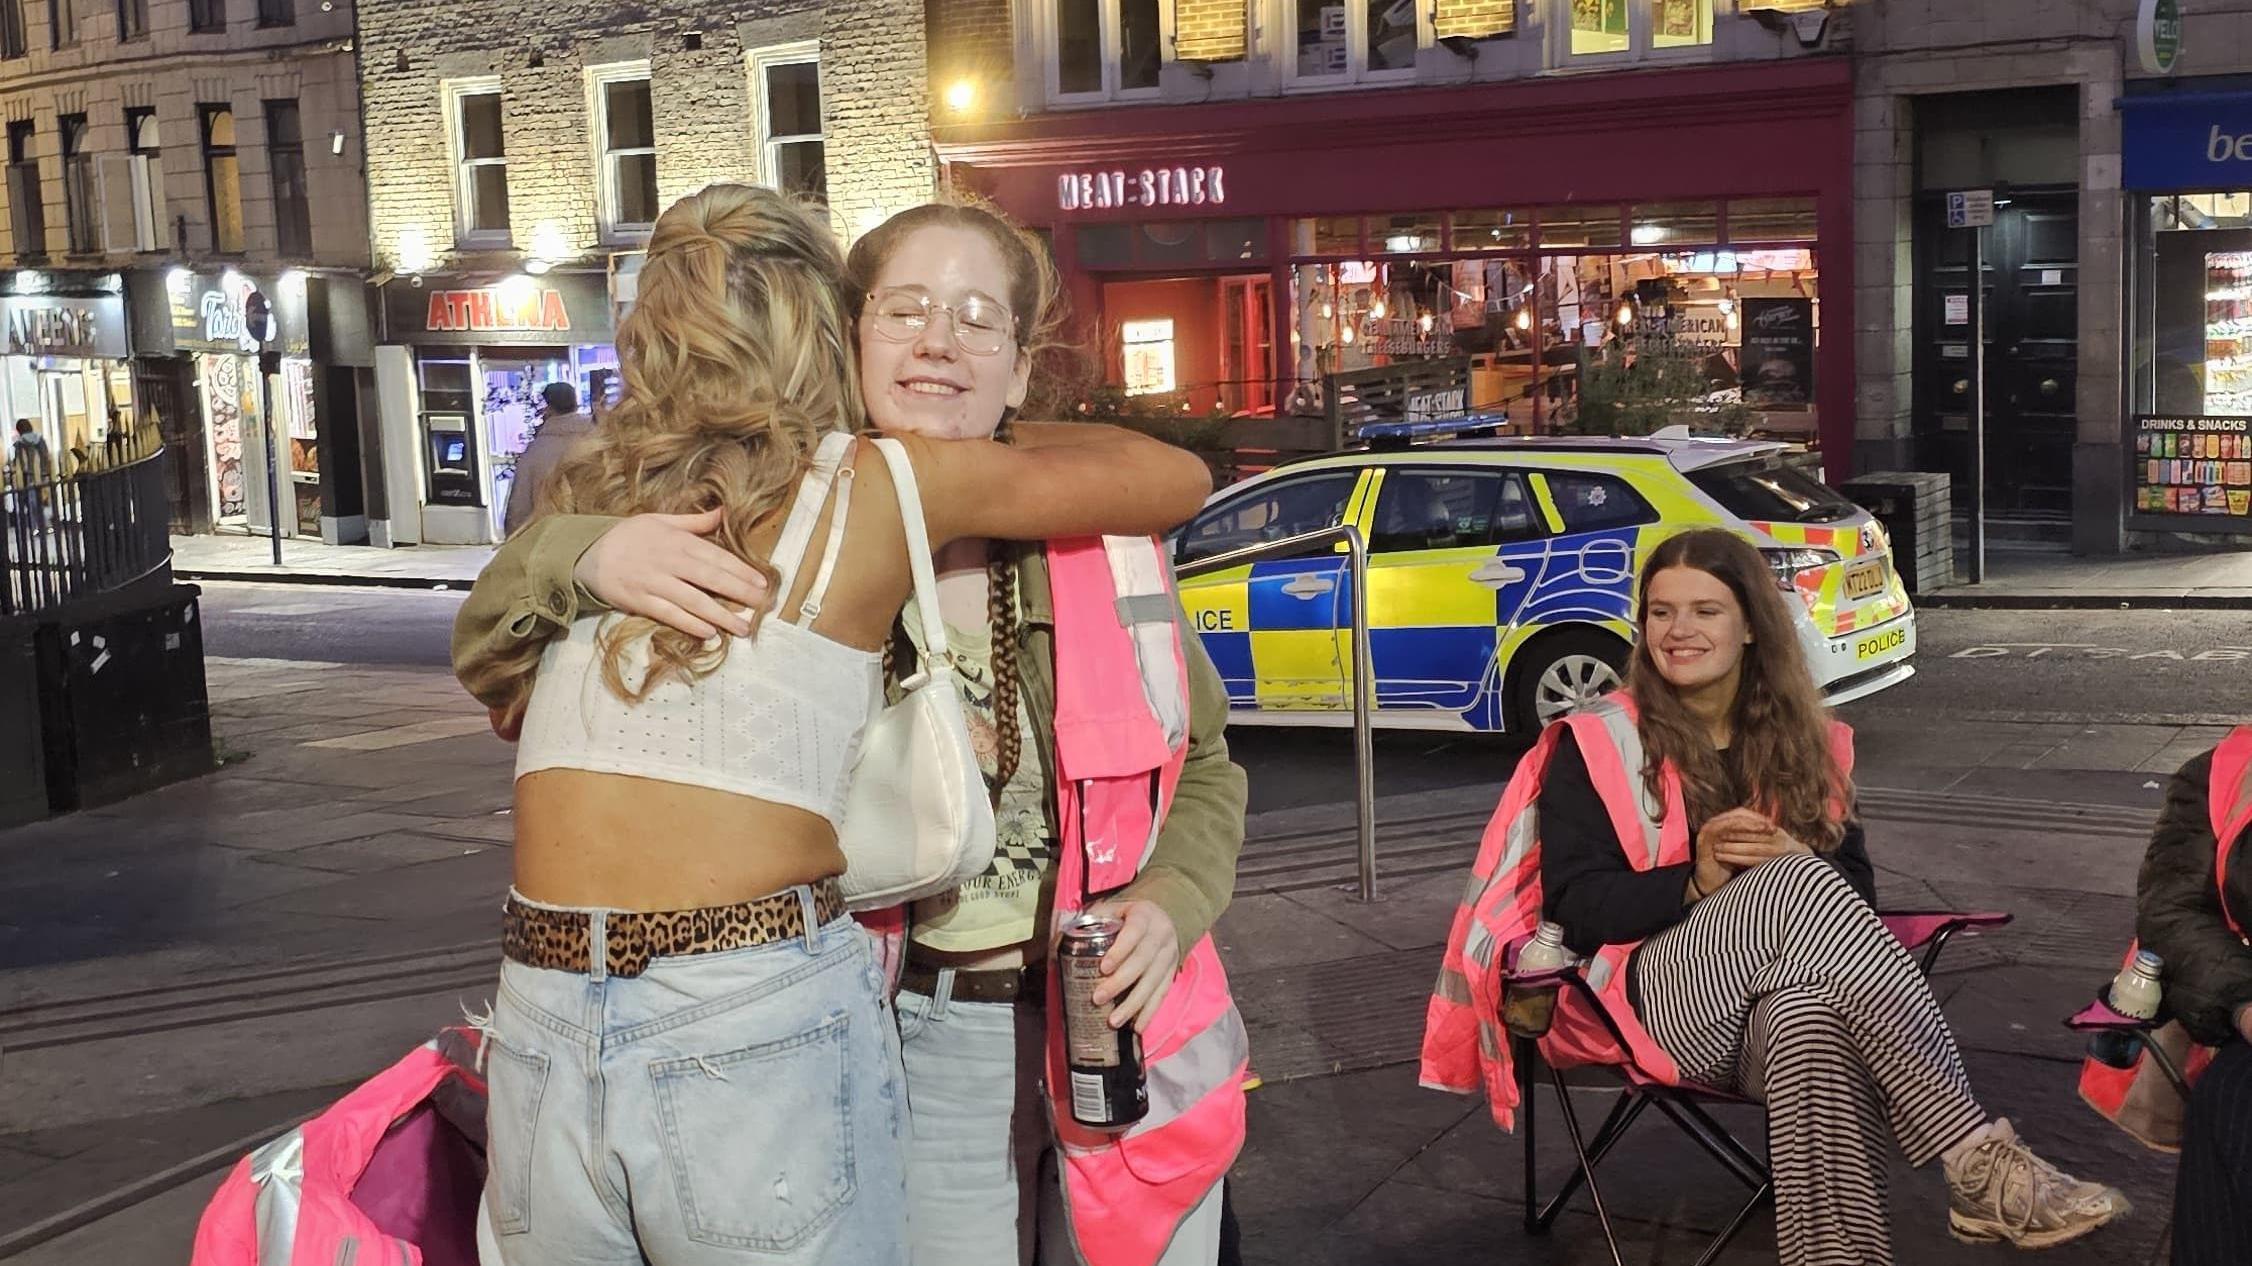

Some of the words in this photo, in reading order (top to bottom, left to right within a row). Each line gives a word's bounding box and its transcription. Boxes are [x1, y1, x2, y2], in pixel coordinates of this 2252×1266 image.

[2141, 419, 2184, 430] DRINKS
[2186, 419, 2196, 430] &
[2198, 420, 2247, 431] SNACKS
[1858, 629, 1906, 658] POLICE
